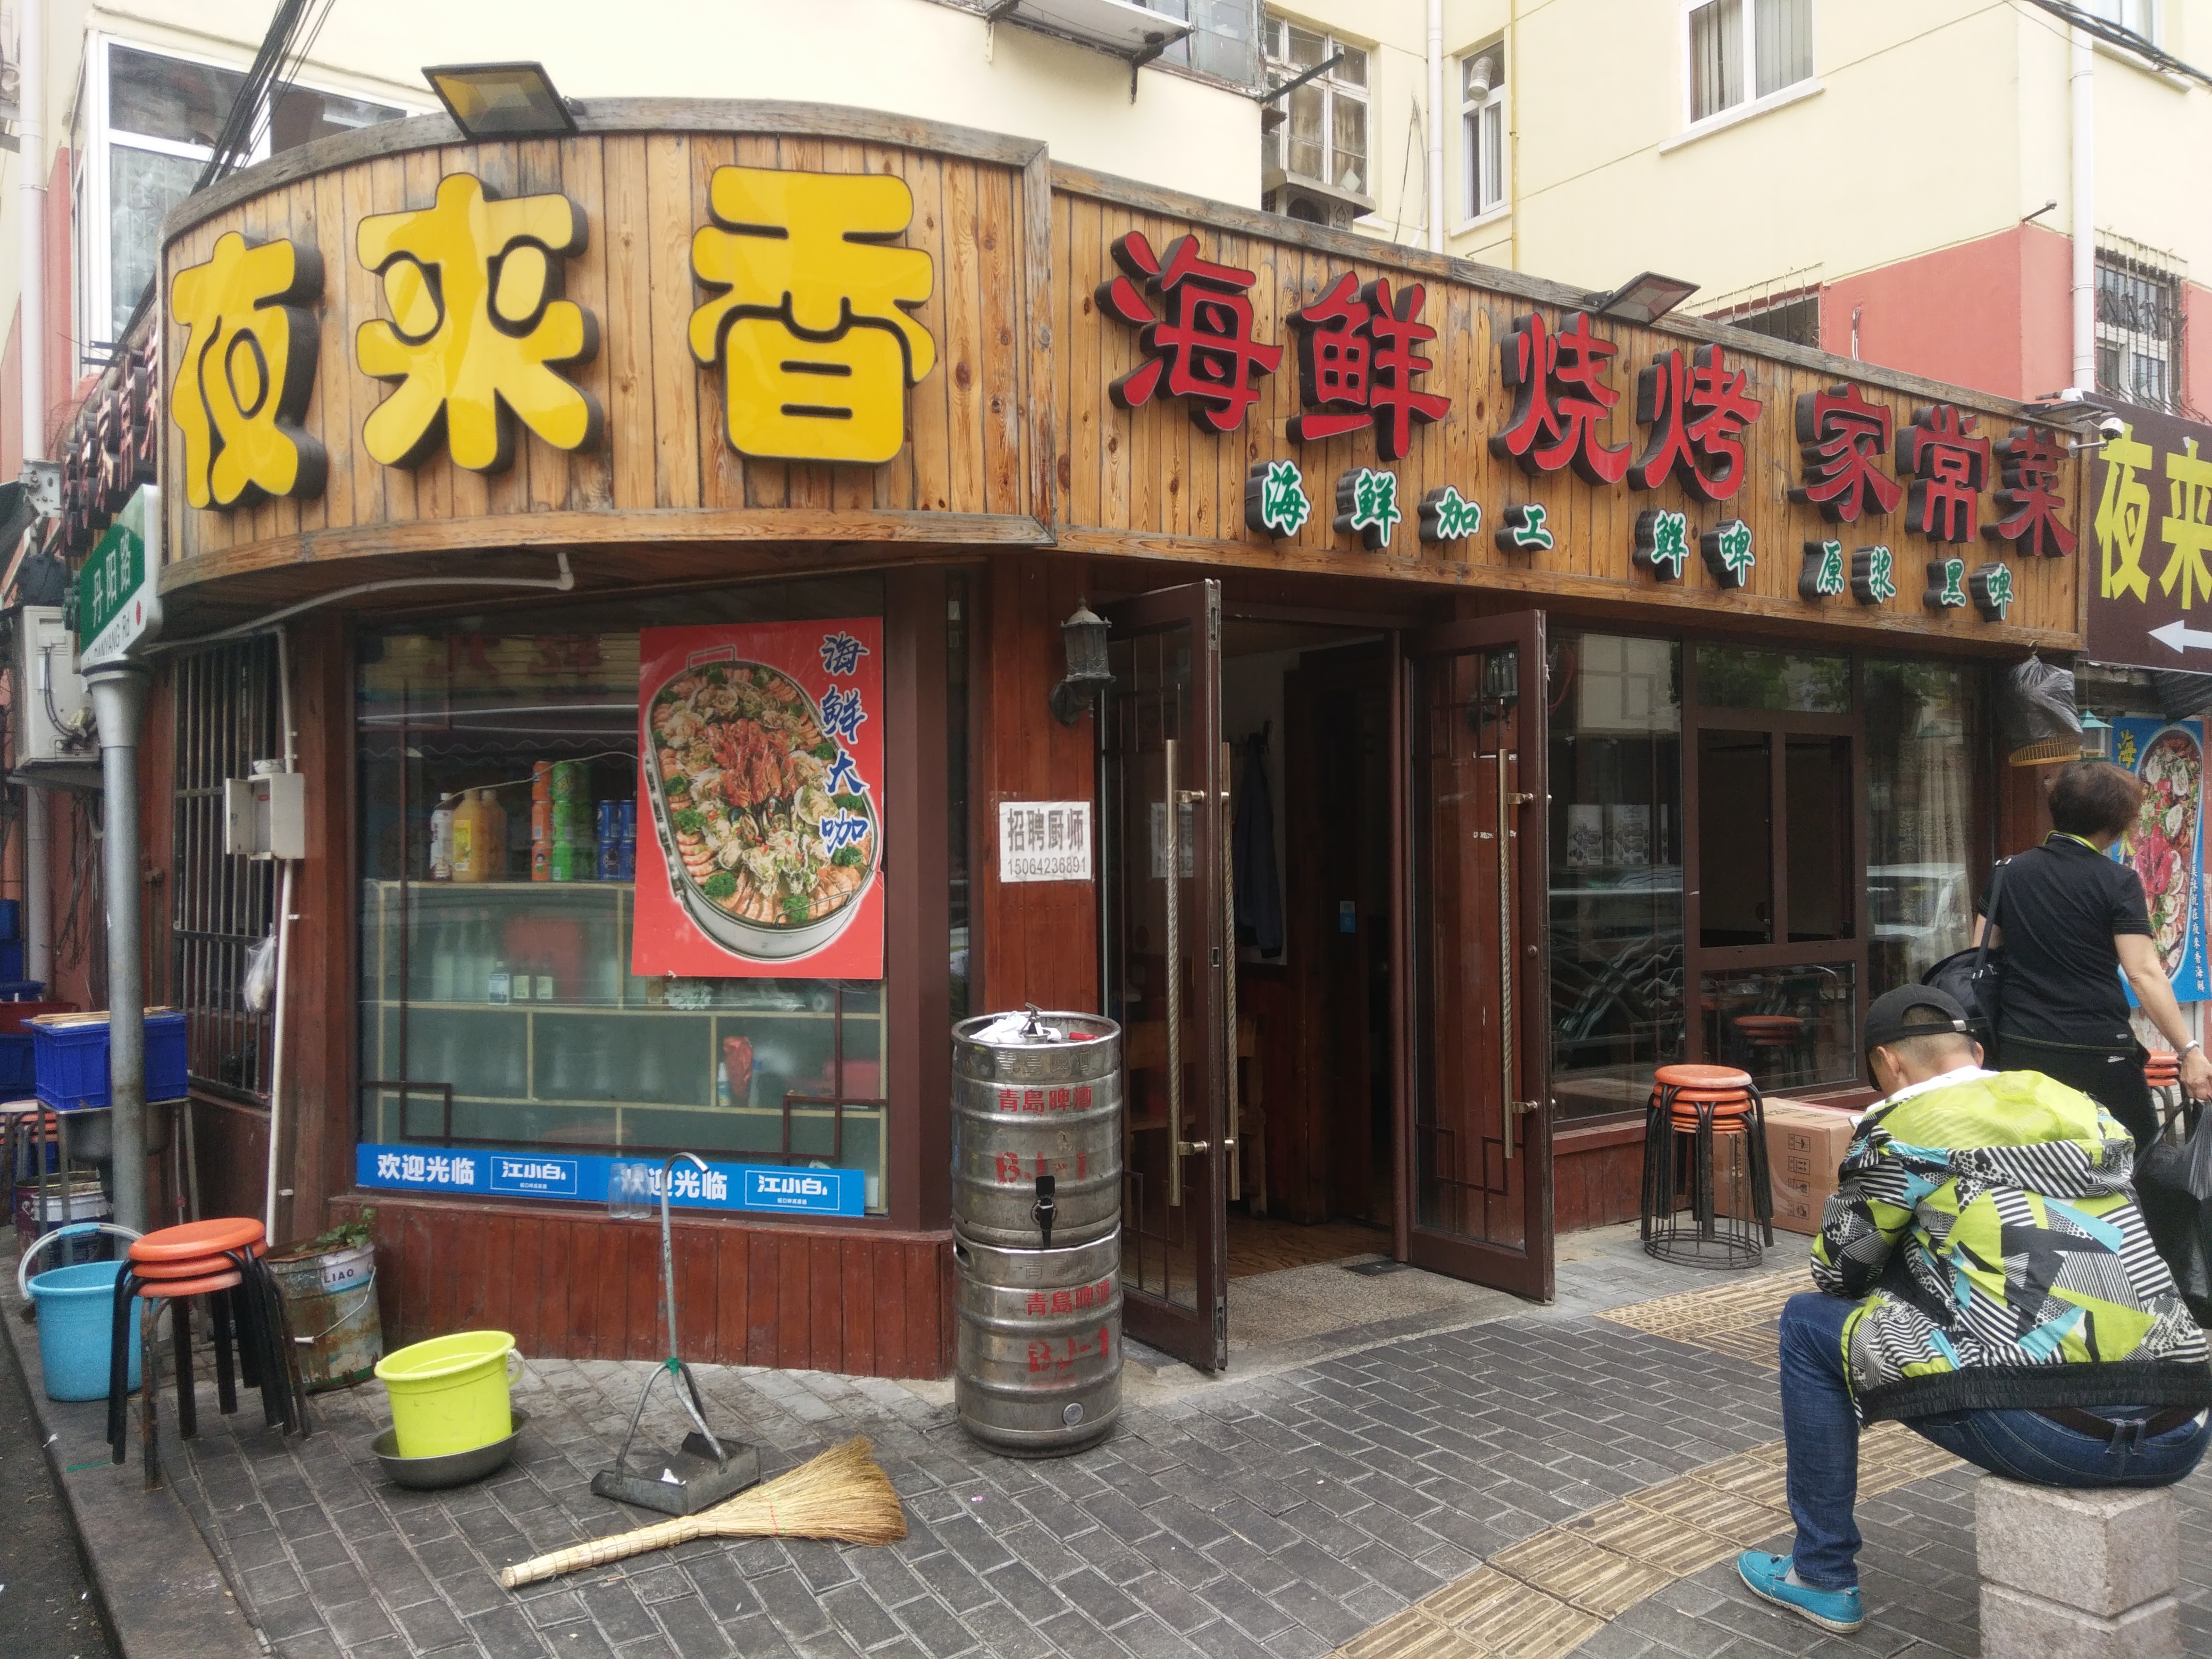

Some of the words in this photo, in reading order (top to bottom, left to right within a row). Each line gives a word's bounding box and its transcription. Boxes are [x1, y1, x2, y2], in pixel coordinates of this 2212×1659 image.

[171, 165, 936, 512] 夜来香
[1096, 231, 1451, 462] 海鲜
[1497, 312, 1762, 501] 烧烤
[1798, 382, 2077, 557] 家常菜
[93, 528, 131, 629] 丹阳路
[1262, 459, 1554, 550] 海鲜加工
[1651, 509, 1755, 587] 鲜啤
[1816, 539, 1897, 603] 原浆
[1941, 558, 2014, 621] 黑啤
[819, 631, 870, 854] 海鲜大咖
[1007, 808, 1084, 851] 招聘厨师
[1008, 856, 1086, 875] 15064236891
[377, 1153, 475, 1186] 欢迎光临
[501, 1161, 564, 1180] 江小白
[757, 1175, 825, 1195] 江小白
